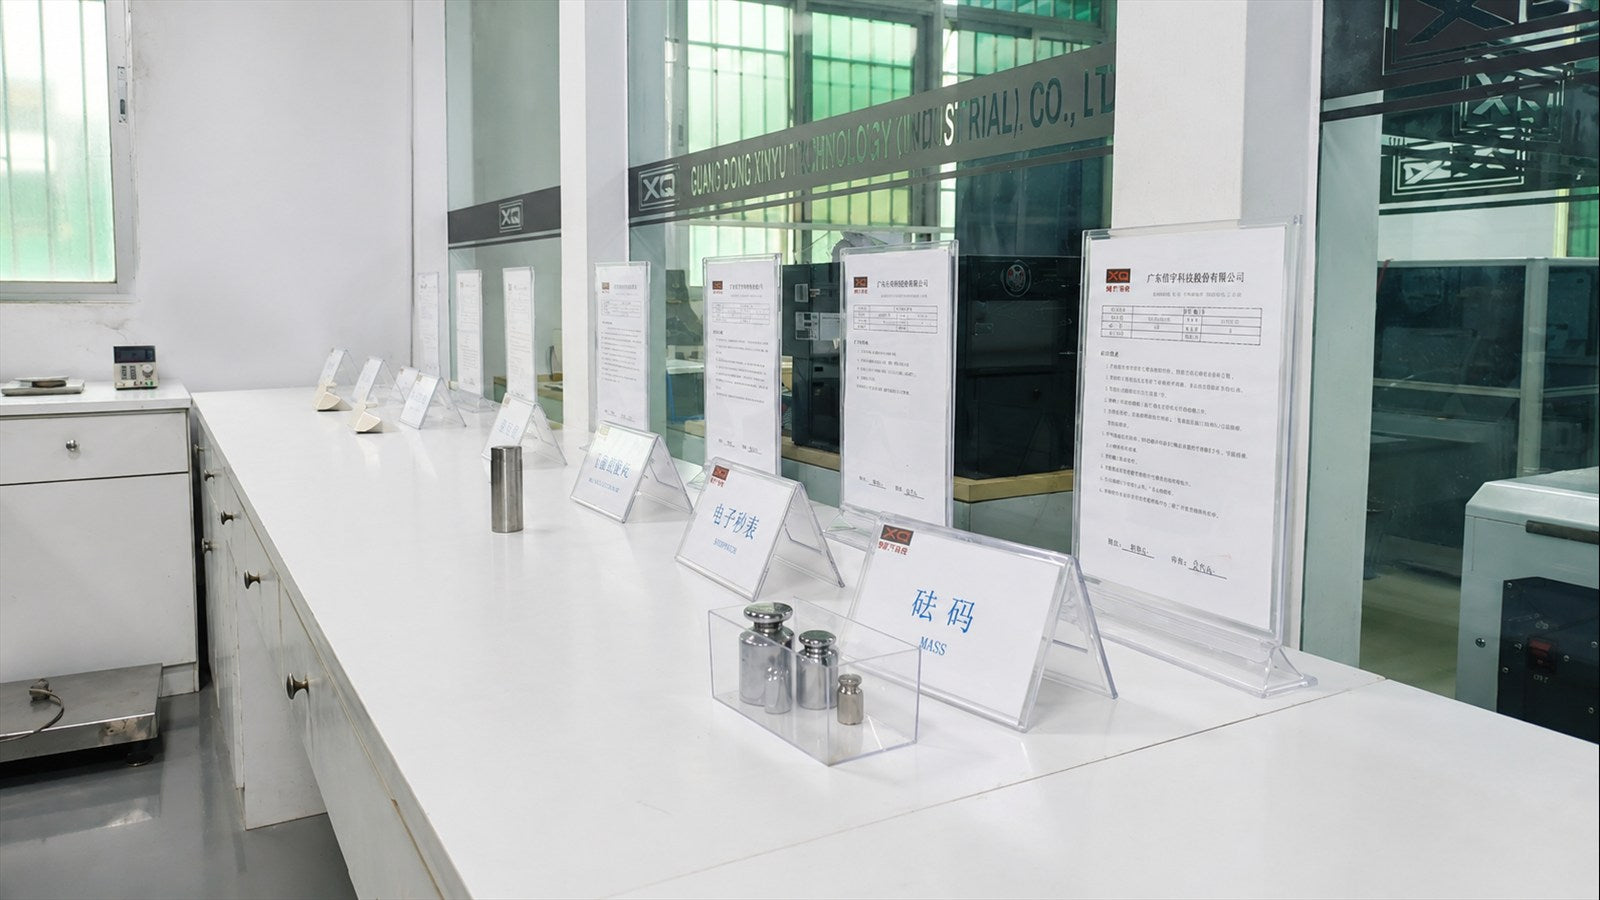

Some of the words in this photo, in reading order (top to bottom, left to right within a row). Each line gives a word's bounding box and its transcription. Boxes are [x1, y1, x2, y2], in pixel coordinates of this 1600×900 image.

[642, 173, 676, 202] XQ
[691, 162, 721, 196] GUANG
[724, 153, 751, 190] DONG
[754, 145, 785, 183] XINYU
[1029, 77, 1076, 128] CO.,
[501, 207, 521, 226] XQ
[1107, 270, 1130, 282] XQ
[712, 503, 760, 540] 电子秒表
[881, 526, 912, 545] XQ
[911, 588, 976, 634] 砝码
[919, 636, 947, 656] MASS
